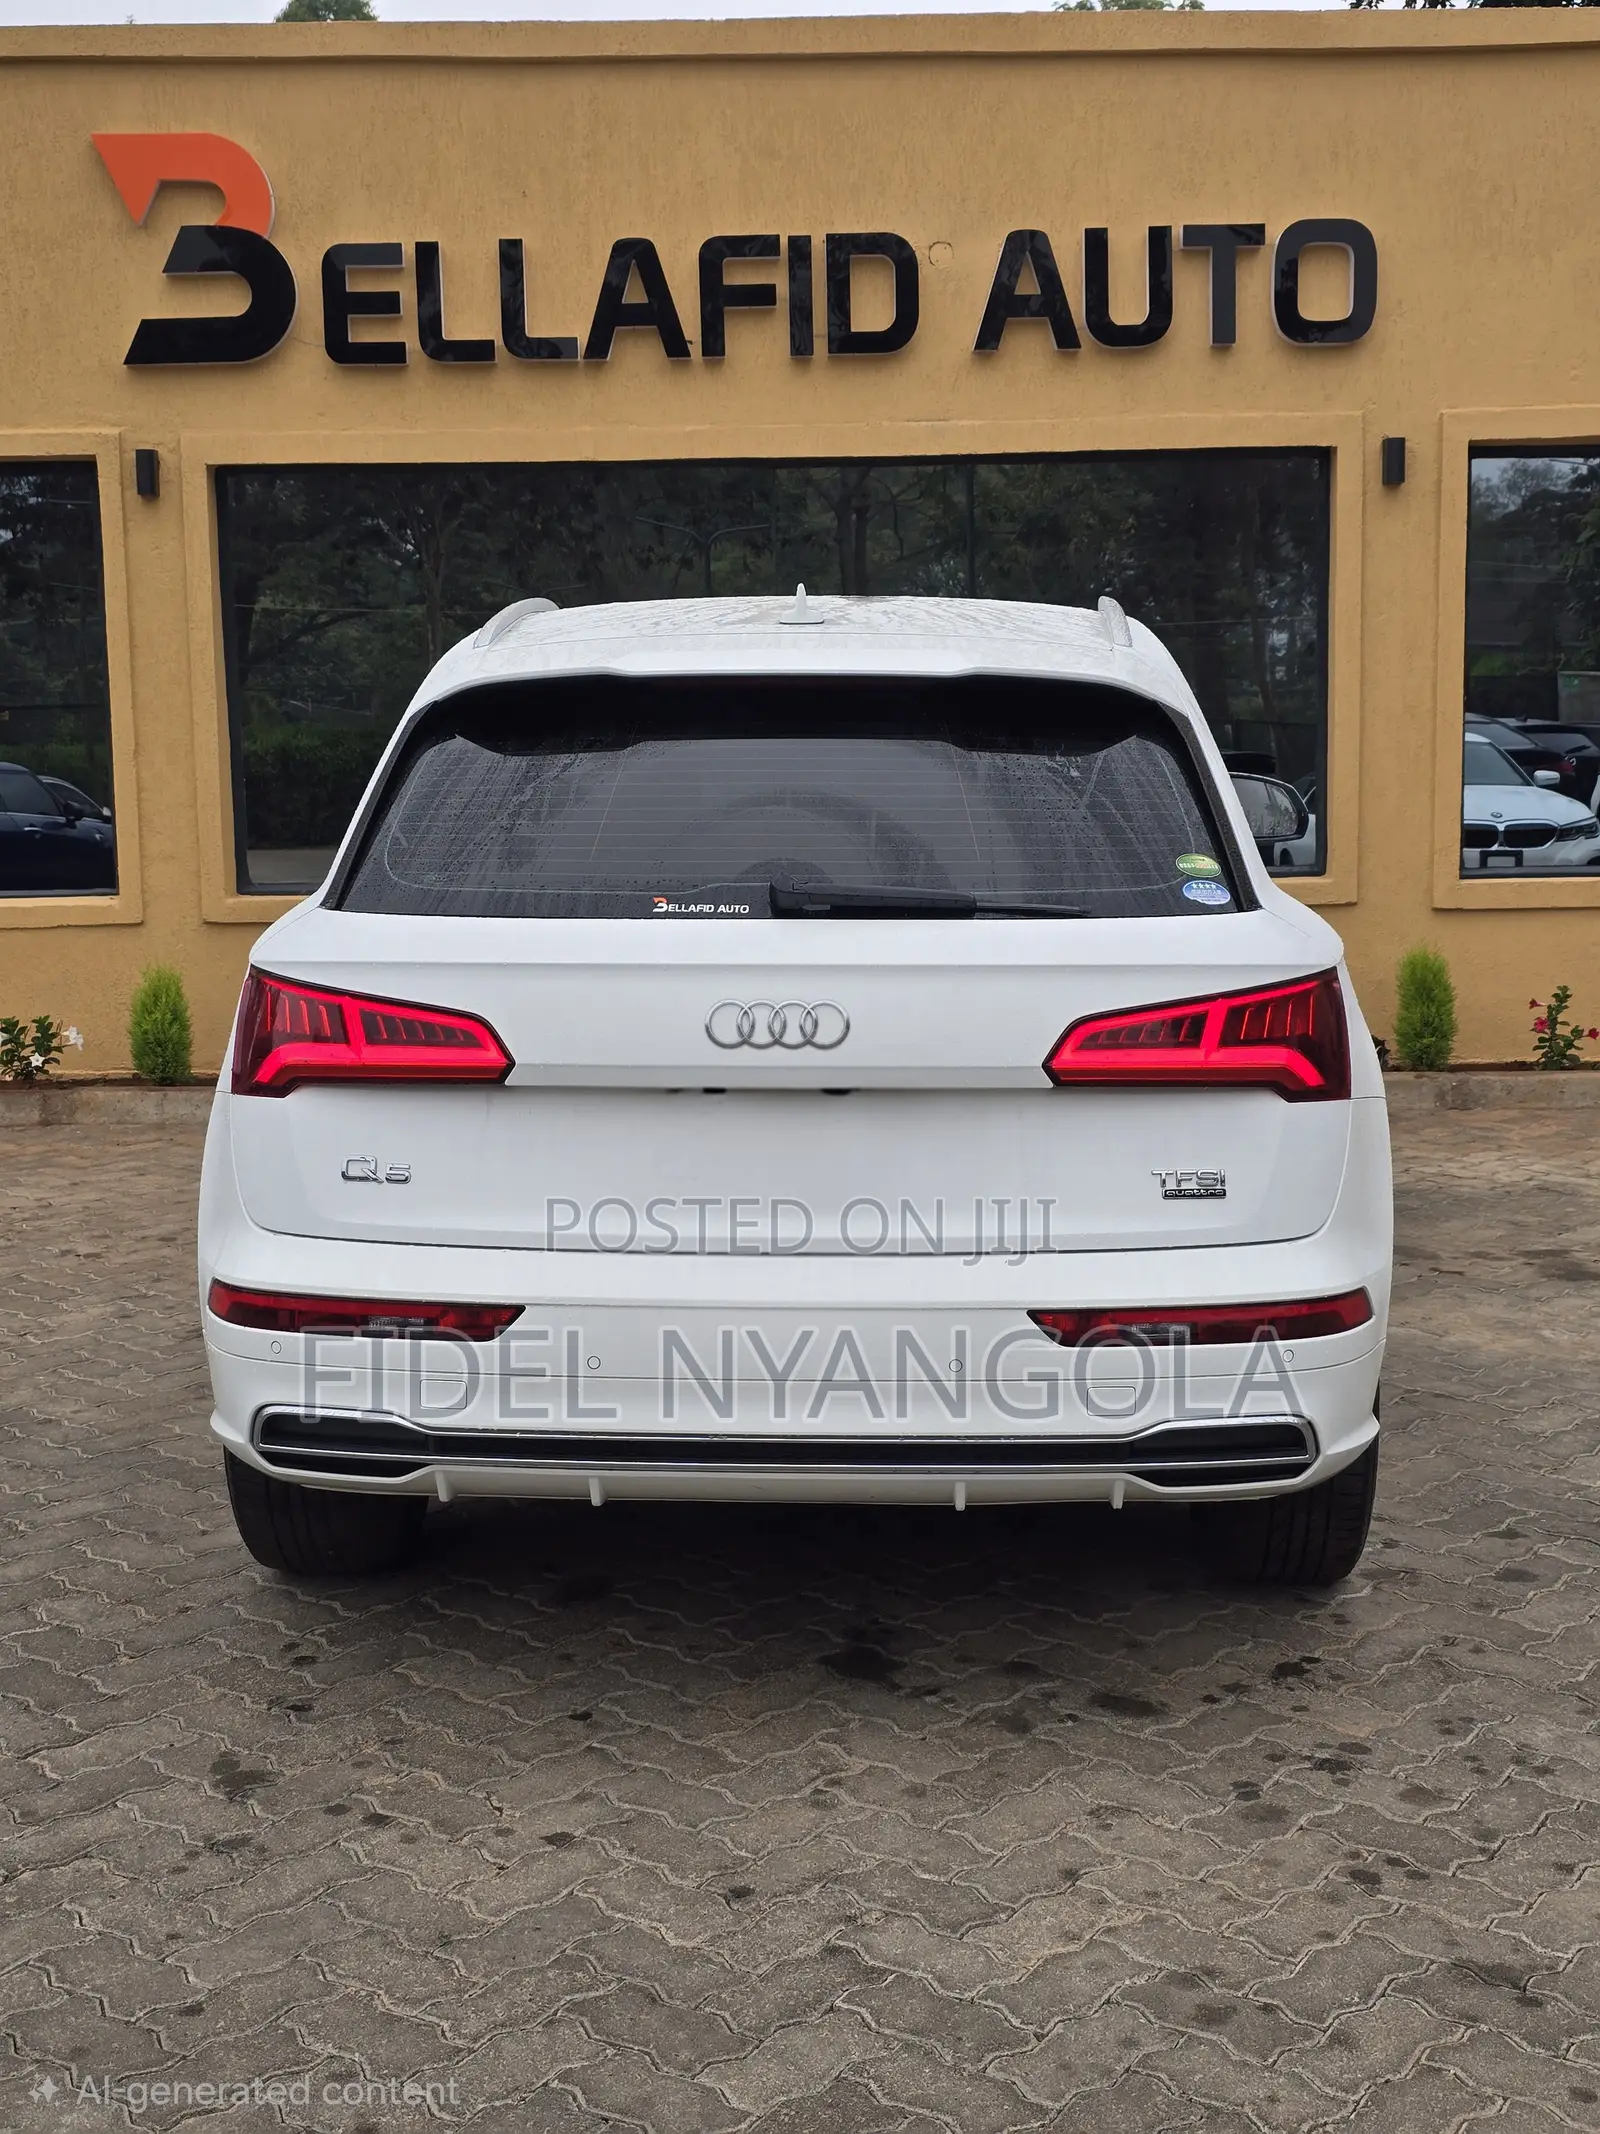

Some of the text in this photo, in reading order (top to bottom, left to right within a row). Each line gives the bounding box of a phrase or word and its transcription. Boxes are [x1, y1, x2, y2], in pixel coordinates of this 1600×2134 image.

[90, 133, 1379, 367] BELLAFID AUTO
[652, 896, 750, 914] BELLAFID AUTO
[340, 1154, 412, 1185] Q5
[1151, 1168, 1226, 1188] TFSI
[1165, 1188, 1225, 1198] quattro
